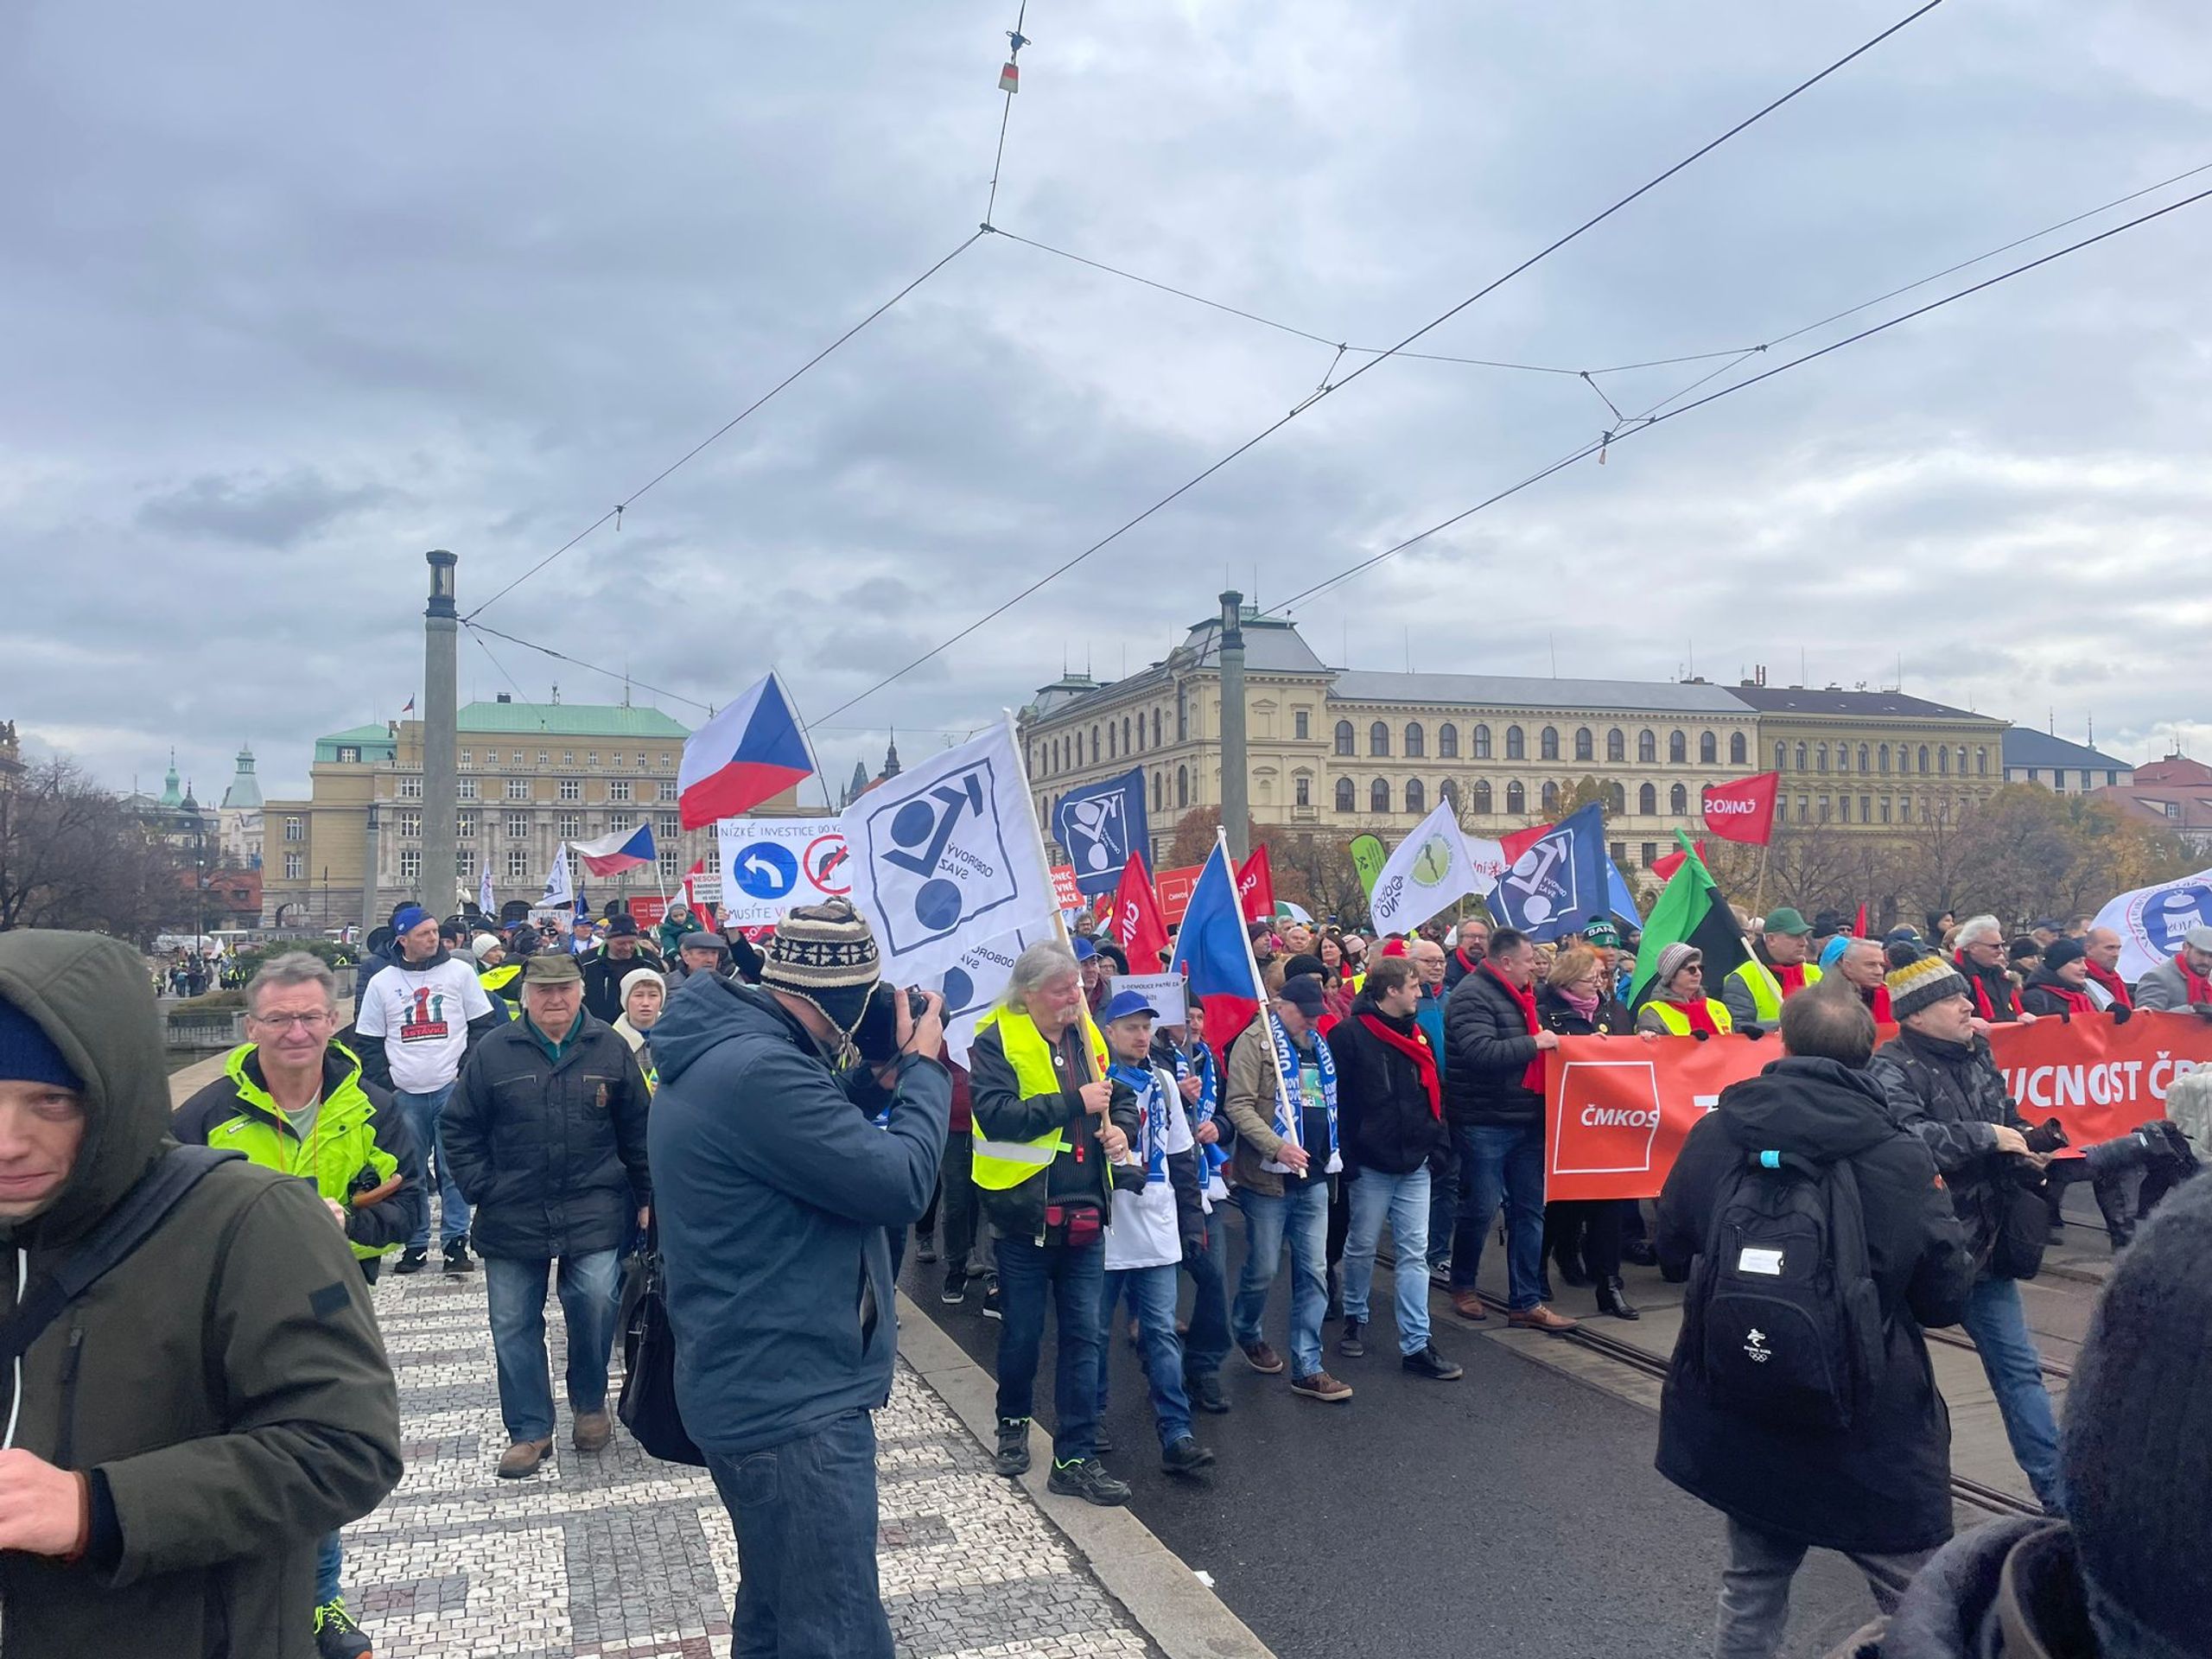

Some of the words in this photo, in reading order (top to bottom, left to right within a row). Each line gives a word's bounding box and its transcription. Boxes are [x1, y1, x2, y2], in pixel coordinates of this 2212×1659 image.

[721, 823, 756, 837] NÍZKÉ
[760, 826, 814, 836] INVESTICE
[817, 824, 830, 833] DO
[728, 903, 771, 919] MUSÍTE
[2001, 1061, 2142, 1107] UCNOST
[1580, 1103, 1660, 1128] ČMKOS
